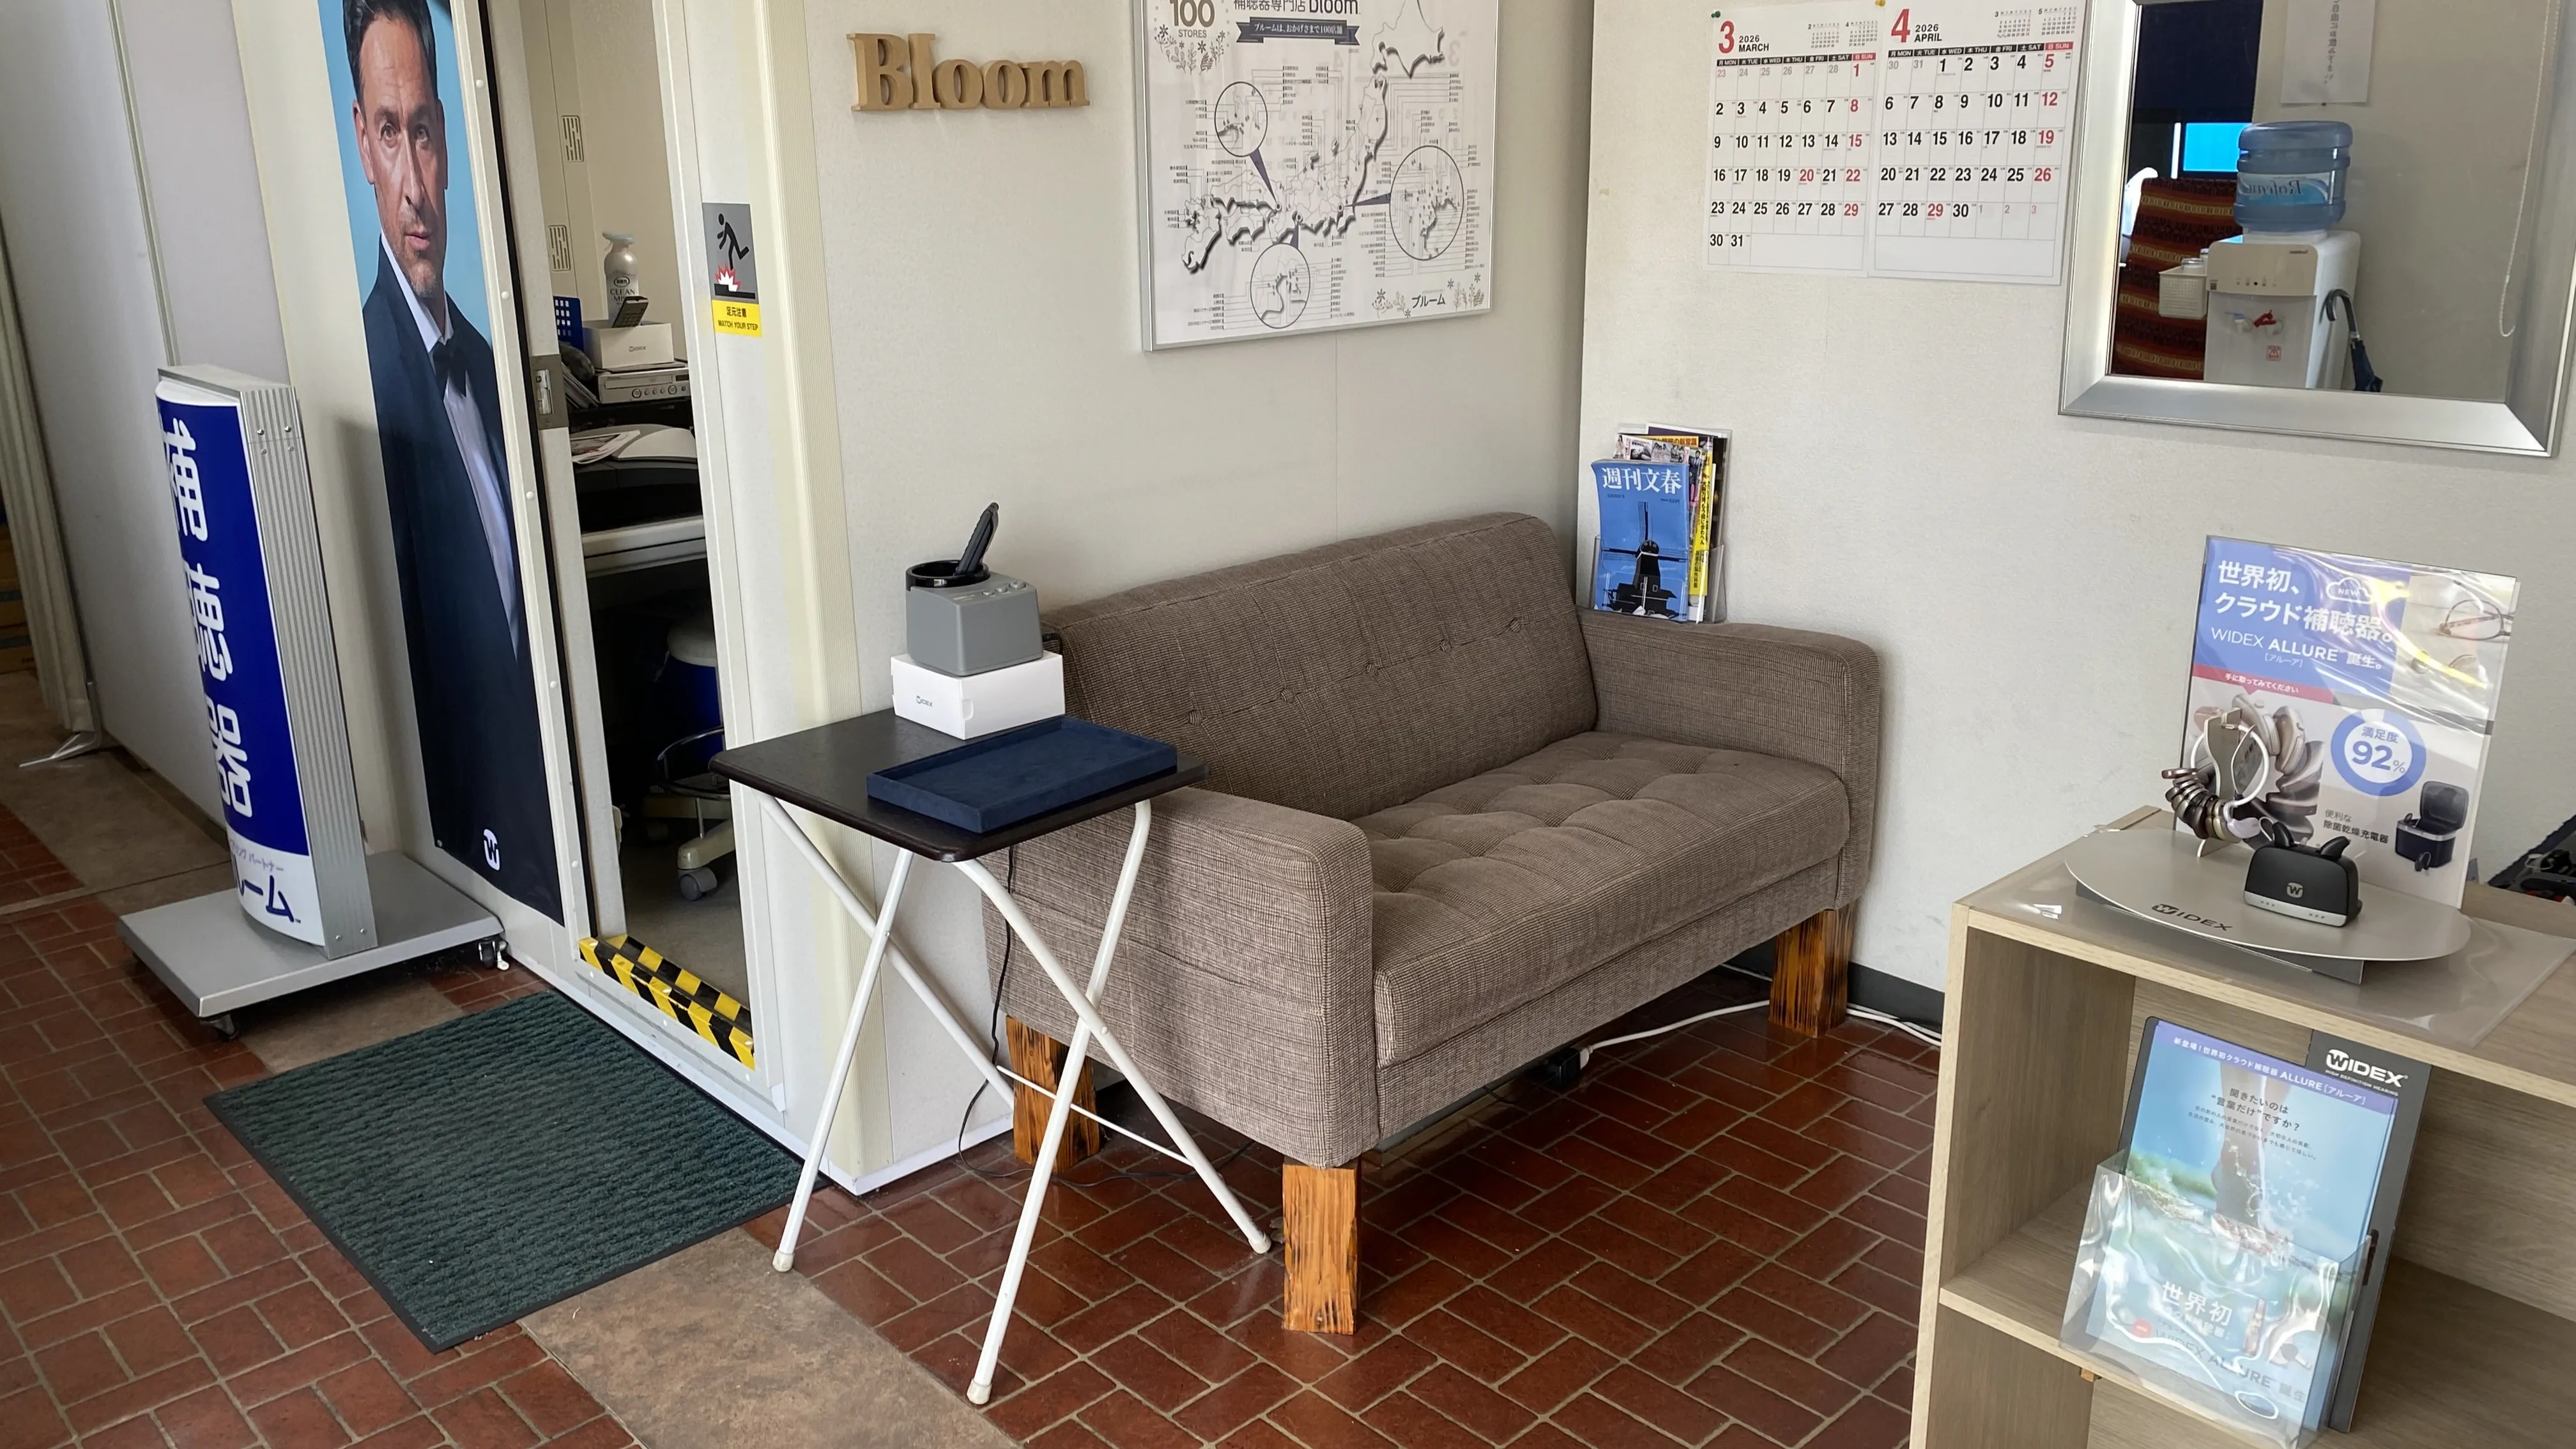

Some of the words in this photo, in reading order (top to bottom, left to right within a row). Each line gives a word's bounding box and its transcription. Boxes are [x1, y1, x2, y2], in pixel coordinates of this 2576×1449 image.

[1170, 0, 1215, 27] 100
[1178, 29, 1207, 38] STORES
[1891, 8, 1910, 43] 4
[1719, 21, 1735, 53] 3
[1915, 33, 1942, 42] APRIL
[1739, 43, 1769, 52] MARCH
[1853, 63, 1859, 76] 1
[1940, 59, 1945, 72] 1
[1965, 58, 1973, 71] 2
[1990, 57, 1998, 70] 3
[2017, 56, 2026, 68] 4
[2044, 54, 2054, 68] 5
[847, 33, 1090, 111] Bloom
[1716, 103, 1723, 114] 2
[1737, 102, 1745, 114] 3
[1759, 102, 1766, 114] 4
[1781, 101, 1788, 113] 5
[1804, 100, 1811, 112] 6
[1827, 100, 1835, 112] 7
[1850, 99, 1858, 112] 8
[1885, 96, 1894, 109] 6
[1910, 96, 1919, 109] 7
[1935, 95, 1943, 109] 8
[1961, 95, 1968, 108] 9
[1988, 94, 2002, 107] 10
[2014, 93, 2028, 107] 11
[2042, 92, 2058, 106] 12
[1714, 135, 1721, 148] 9
[1736, 135, 1748, 148] 10
[1758, 135, 1768, 148] 11
[1779, 135, 1792, 148] 12
[1802, 135, 1814, 147] 13
[1825, 135, 1838, 147] 14
[1849, 134, 1862, 147] 15
[1883, 132, 1896, 145] 13
[1908, 132, 1922, 145] 14
[1933, 132, 1947, 144] 15
[1958, 132, 1973, 144] 16
[1984, 131, 2000, 144] 17
[2011, 131, 2026, 144] 18
[2039, 130, 2054, 144] 19
[1713, 169, 1725, 181] 16
[1735, 169, 1747, 181] 17
[1756, 169, 1768, 181] 18
[1778, 169, 1790, 181] 19
[1800, 169, 1814, 181] 20
[1823, 169, 1836, 181] 21
[1846, 169, 1860, 182] 22
[1881, 168, 1896, 181] 20
[1905, 168, 1919, 181] 21
[1930, 168, 1945, 181] 22
[1955, 168, 1971, 181] 23
[1981, 168, 1997, 181] 24
[2007, 168, 2024, 181] 25
[2034, 168, 2051, 181] 26
[1712, 202, 1724, 214] 23
[1733, 202, 1745, 214] 24
[1754, 203, 1767, 215] 25
[1775, 203, 1789, 215] 26
[1798, 203, 1812, 215] 27
[1821, 203, 1835, 216] 28
[1844, 203, 1859, 216] 29
[1879, 203, 1894, 215] 27
[1903, 203, 1917, 216] 28
[1928, 204, 1943, 216] 29
[1953, 204, 1968, 217] 30
[1710, 234, 1722, 246] 30
[1731, 234, 1743, 247] 31
[1412, 294, 1445, 309] ブルーム
[726, 307, 747, 318] 足元注意
[747, 323, 758, 331] STEP
[1602, 467, 1682, 494] 週刊文春
[2218, 560, 2300, 595] 世界初、
[2338, 588, 2361, 596] NEW
[2215, 592, 2393, 643] クラウド補聴器。
[2211, 627, 2264, 648] WIDEX
[2268, 639, 2338, 662] ALLURE
[2225, 673, 2299, 693] 手に取ってみてください
[2361, 726, 2399, 744] 満足度
[2325, 809, 2352, 823] 便利な
[2323, 820, 2389, 843] 除菌乾燥充電器
[2152, 903, 2232, 931] WIDEX
[2326, 1049, 2405, 1087] WIDEX
[2280, 1071, 2323, 1091] ALLURE
[2230, 1088, 2289, 1114] 聞きたいのは
[2162, 1280, 2233, 1326] 世界初
[2156, 1328, 2204, 1358] WIDEX
